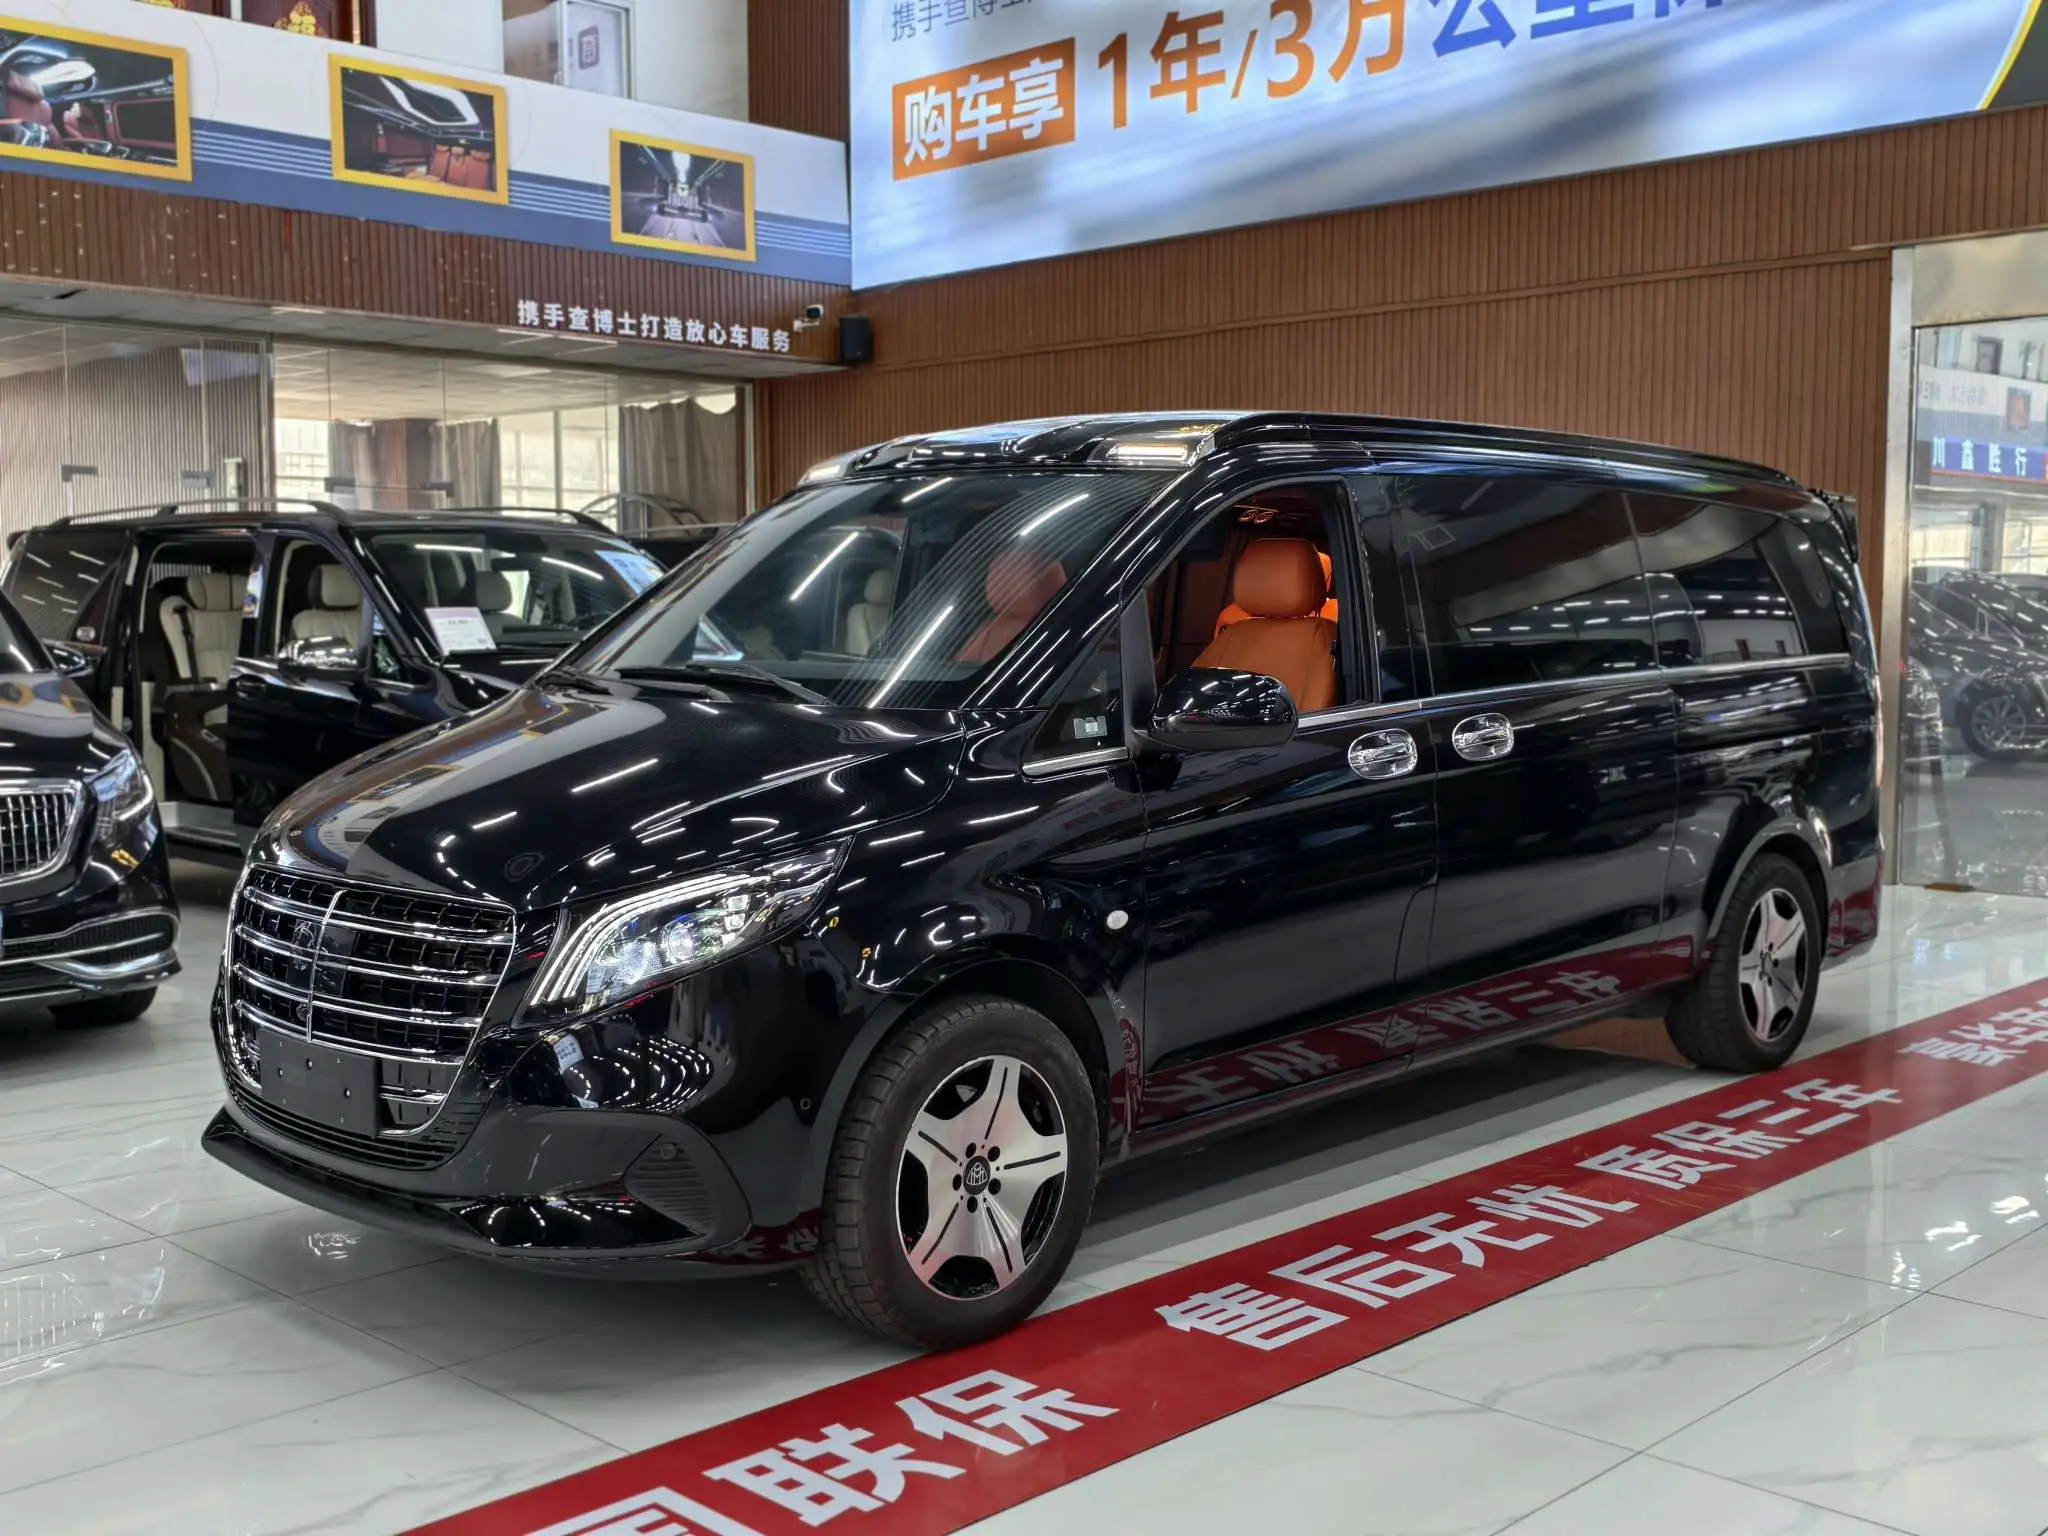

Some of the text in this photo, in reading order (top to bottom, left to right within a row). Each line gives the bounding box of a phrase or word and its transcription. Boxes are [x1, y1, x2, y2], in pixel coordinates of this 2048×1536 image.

[903, 57, 1065, 167] 购车享
[517, 299, 790, 353] 携手查博士打造放心车服务
[1154, 1182, 1640, 1352] 售后无忧
[1574, 1078, 1904, 1190] 质保三年
